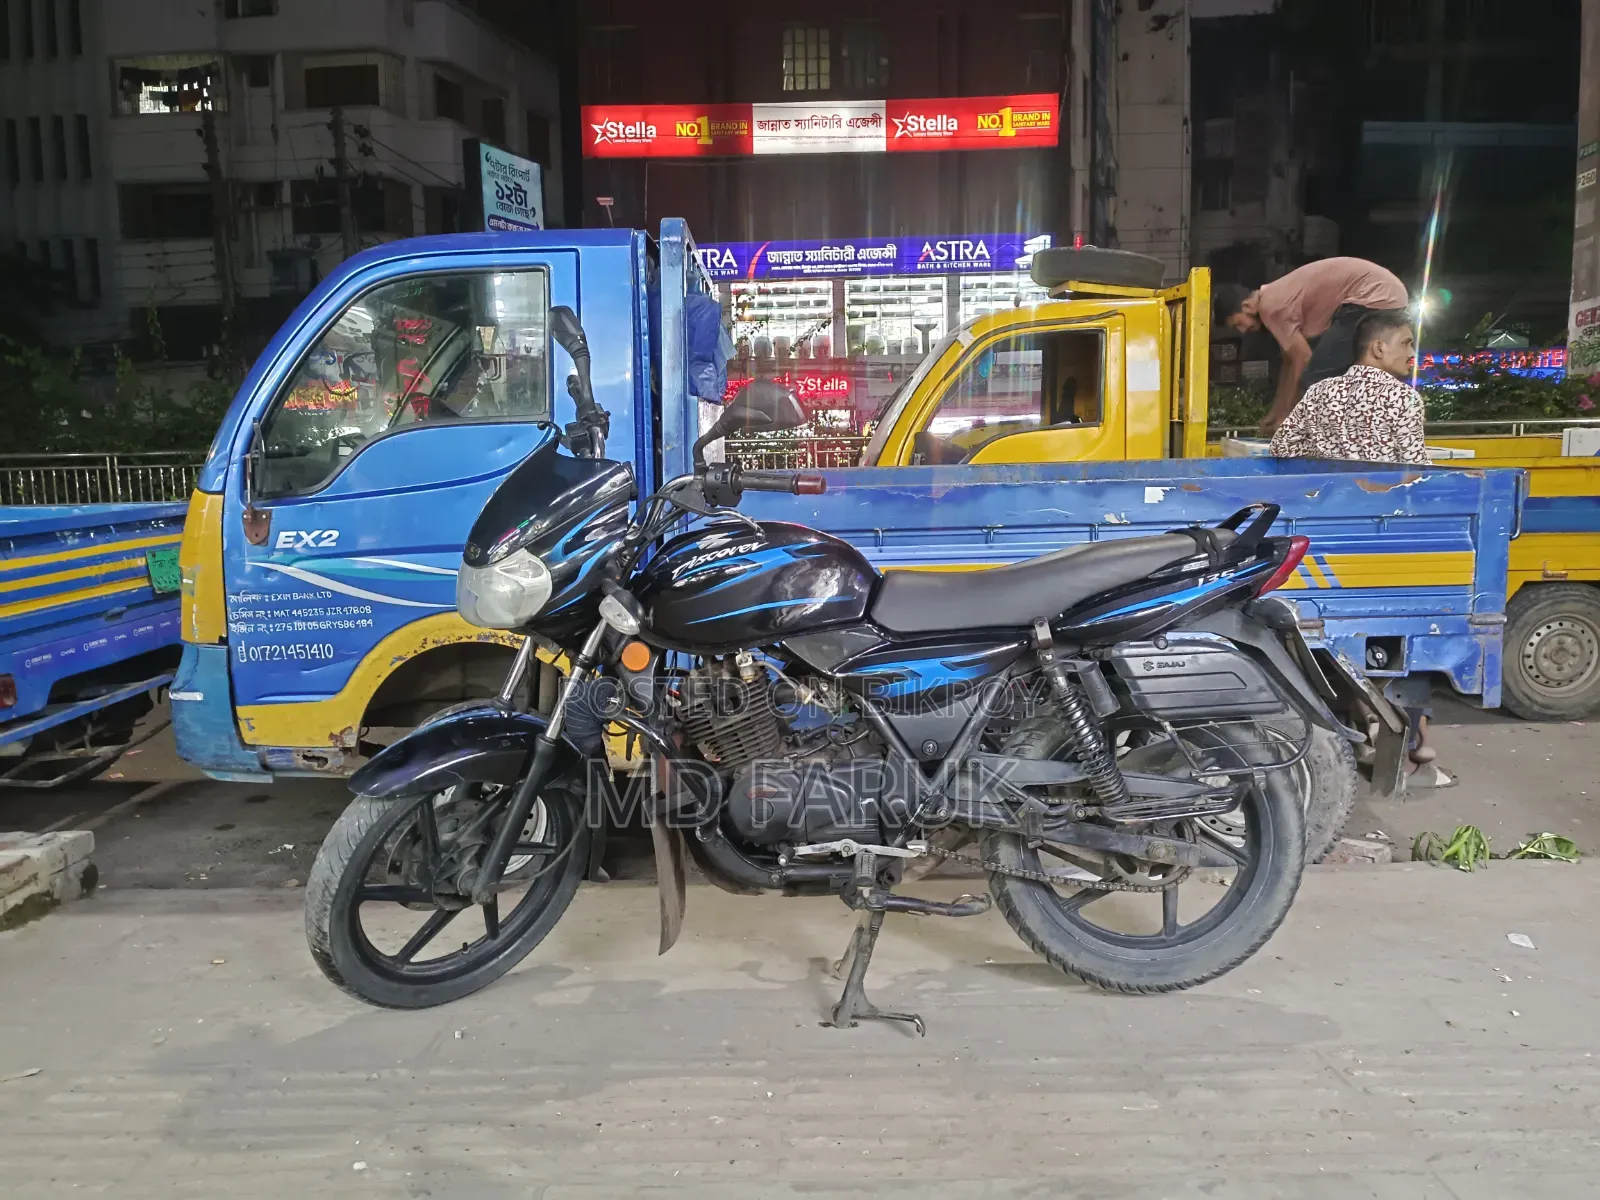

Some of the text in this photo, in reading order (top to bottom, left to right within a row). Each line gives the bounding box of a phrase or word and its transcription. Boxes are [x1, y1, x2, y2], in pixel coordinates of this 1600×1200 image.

[906, 114, 958, 132] Stella
[1012, 111, 1051, 122] BRAND IN
[607, 121, 657, 138] Stella
[711, 121, 748, 131] BRAND IN
[756, 119, 792, 133] জান্নাত
[495, 181, 527, 208] ১২টা
[766, 250, 803, 265] জান্নাত
[918, 240, 991, 261] ASTRA
[275, 529, 340, 549] EX2
[317, 591, 332, 599] LTD
[273, 609, 290, 618] MAT
[292, 607, 325, 617] 445235
[249, 643, 335, 662] 01721451410
